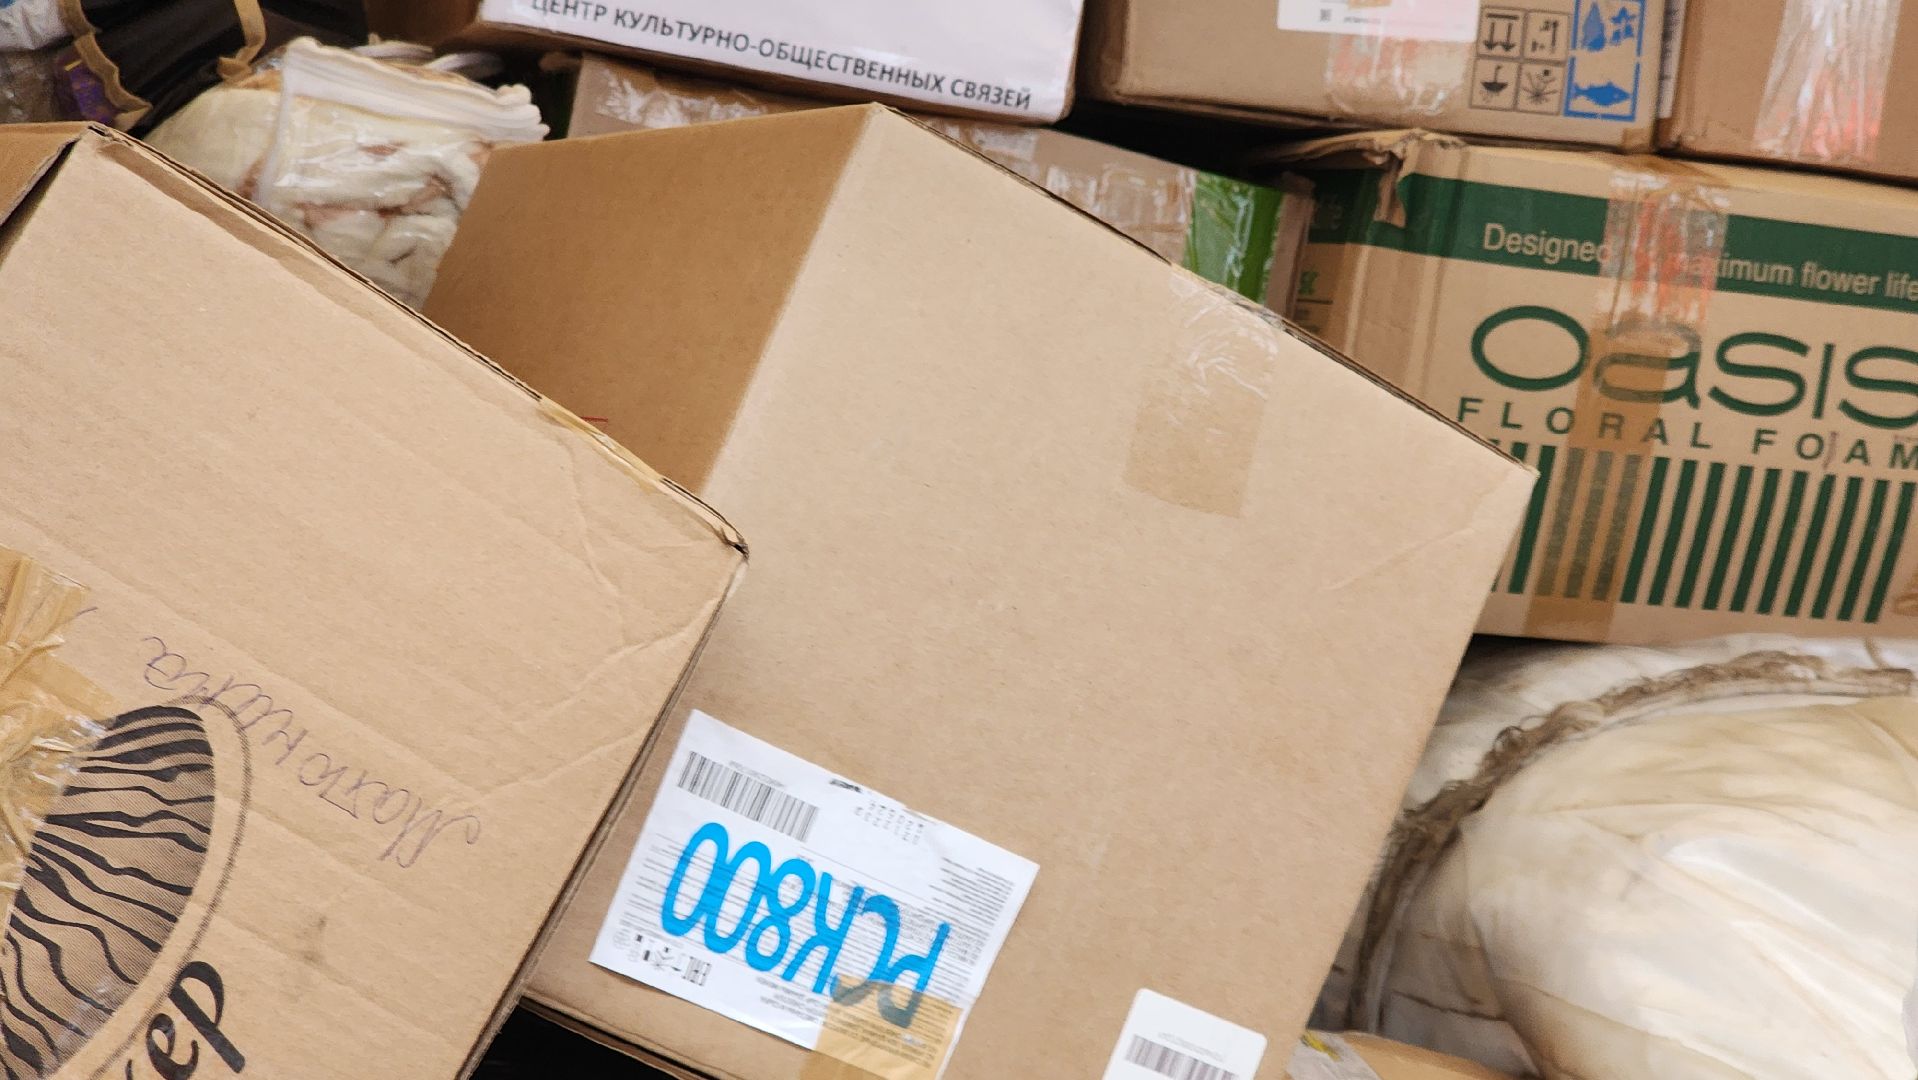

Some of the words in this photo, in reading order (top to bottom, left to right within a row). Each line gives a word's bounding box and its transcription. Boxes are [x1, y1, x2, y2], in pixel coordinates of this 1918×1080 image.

[532, 0, 607, 21] ЦЕНТР
[613, 8, 945, 93] КУЛЬТУРНО-ОБЩЕСТВЕННЫХ
[950, 79, 1032, 110] СВЯЗЕЙ
[1800, 261, 1882, 296] flower
[1456, 397, 1712, 450] FLORAL
[1752, 428, 1918, 470] FOAM
